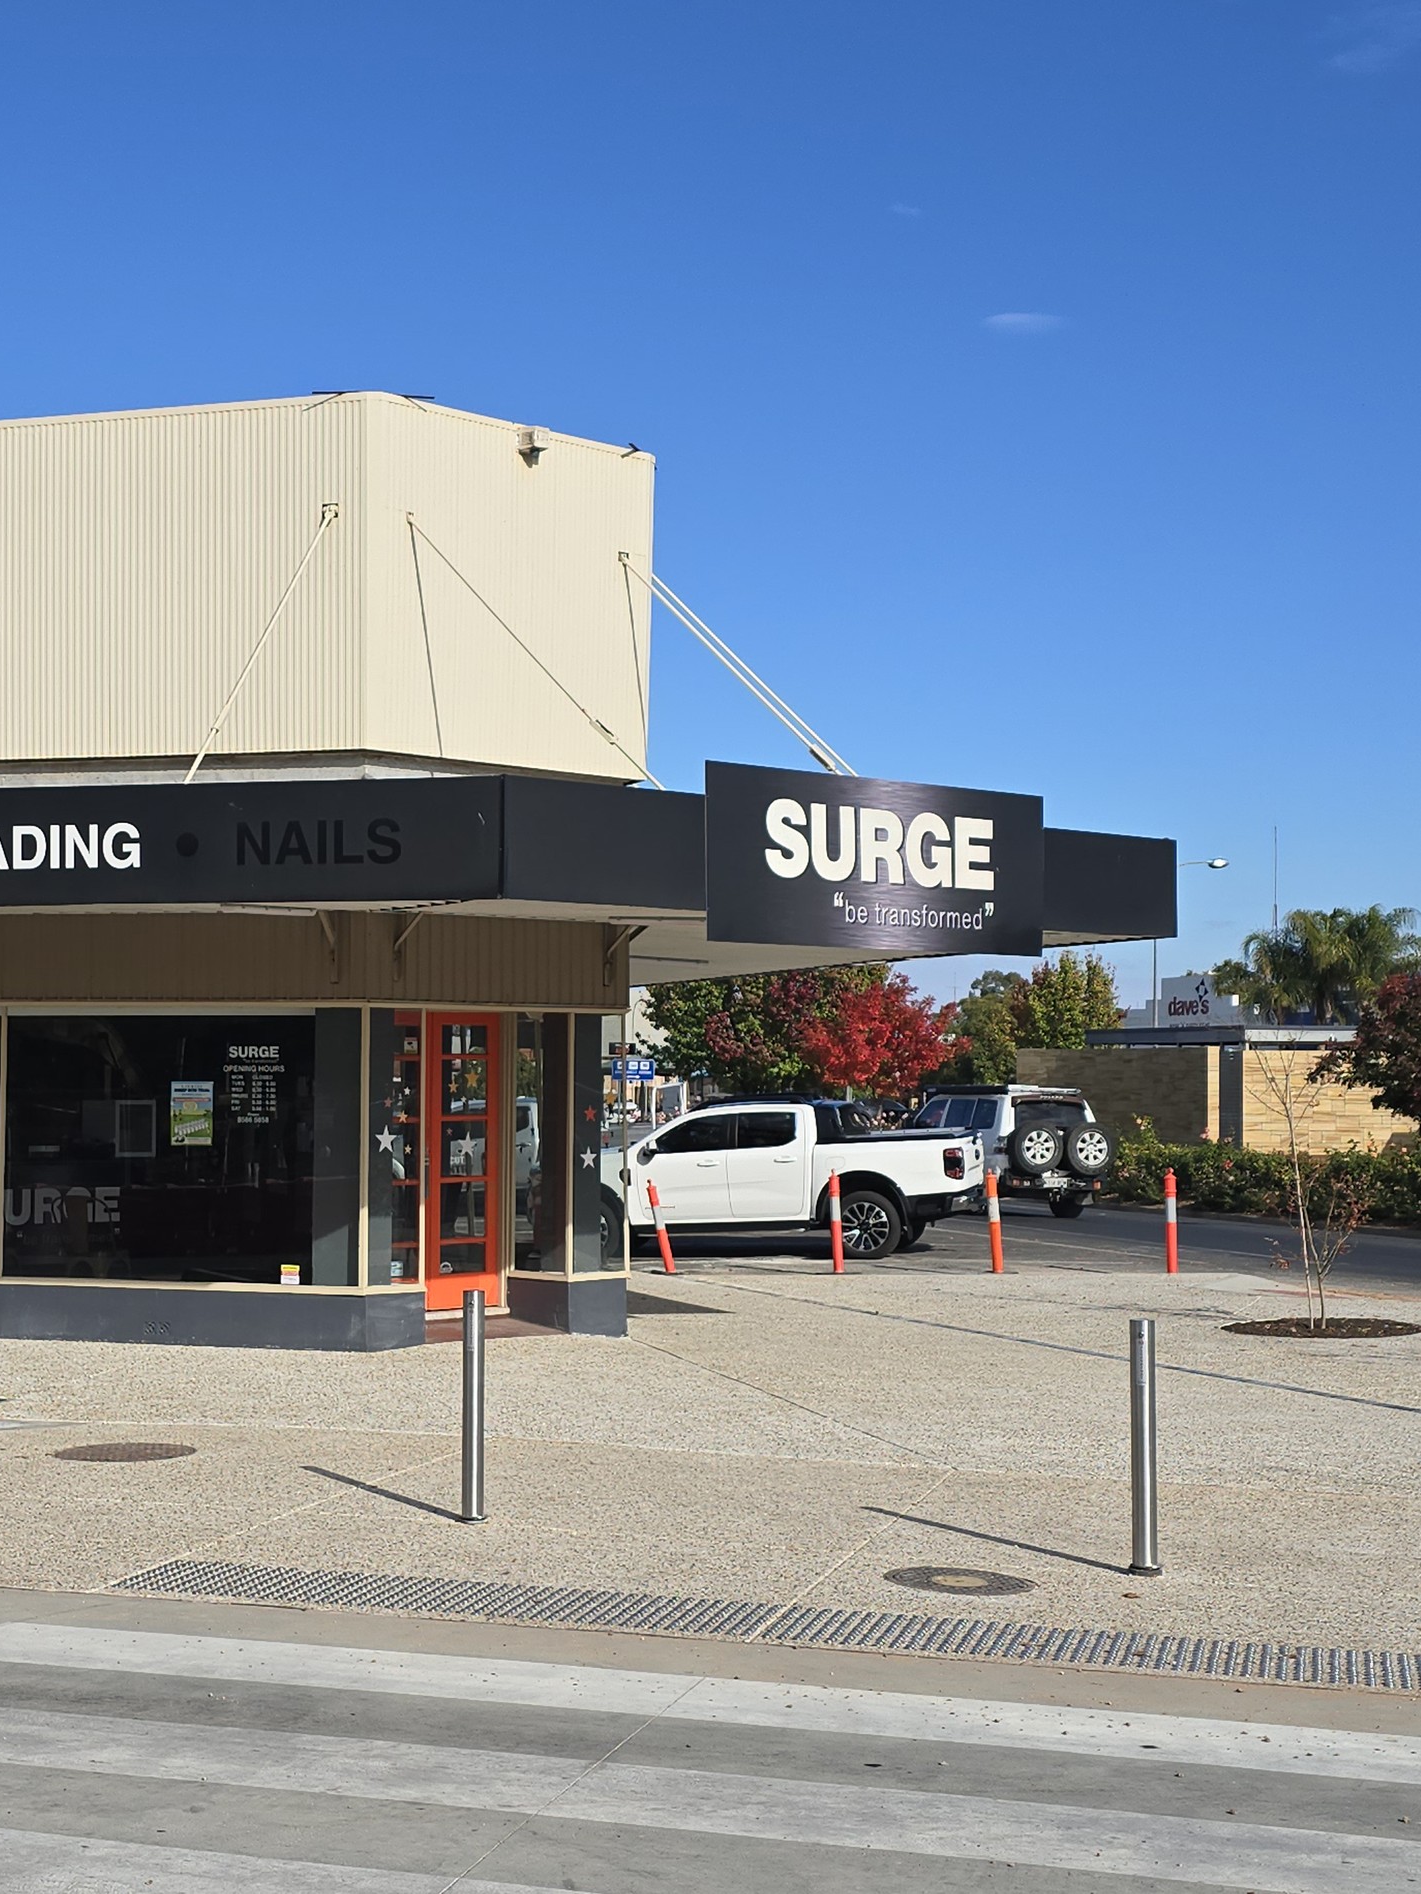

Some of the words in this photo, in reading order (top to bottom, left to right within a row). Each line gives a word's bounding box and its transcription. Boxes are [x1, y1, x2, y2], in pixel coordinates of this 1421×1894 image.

[236, 818, 402, 867] NAILS
[764, 797, 995, 892] SURGE
[228, 1045, 280, 1059] SURGE
[223, 1064, 257, 1073] OPENING
[258, 1065, 285, 1073] HOURS
